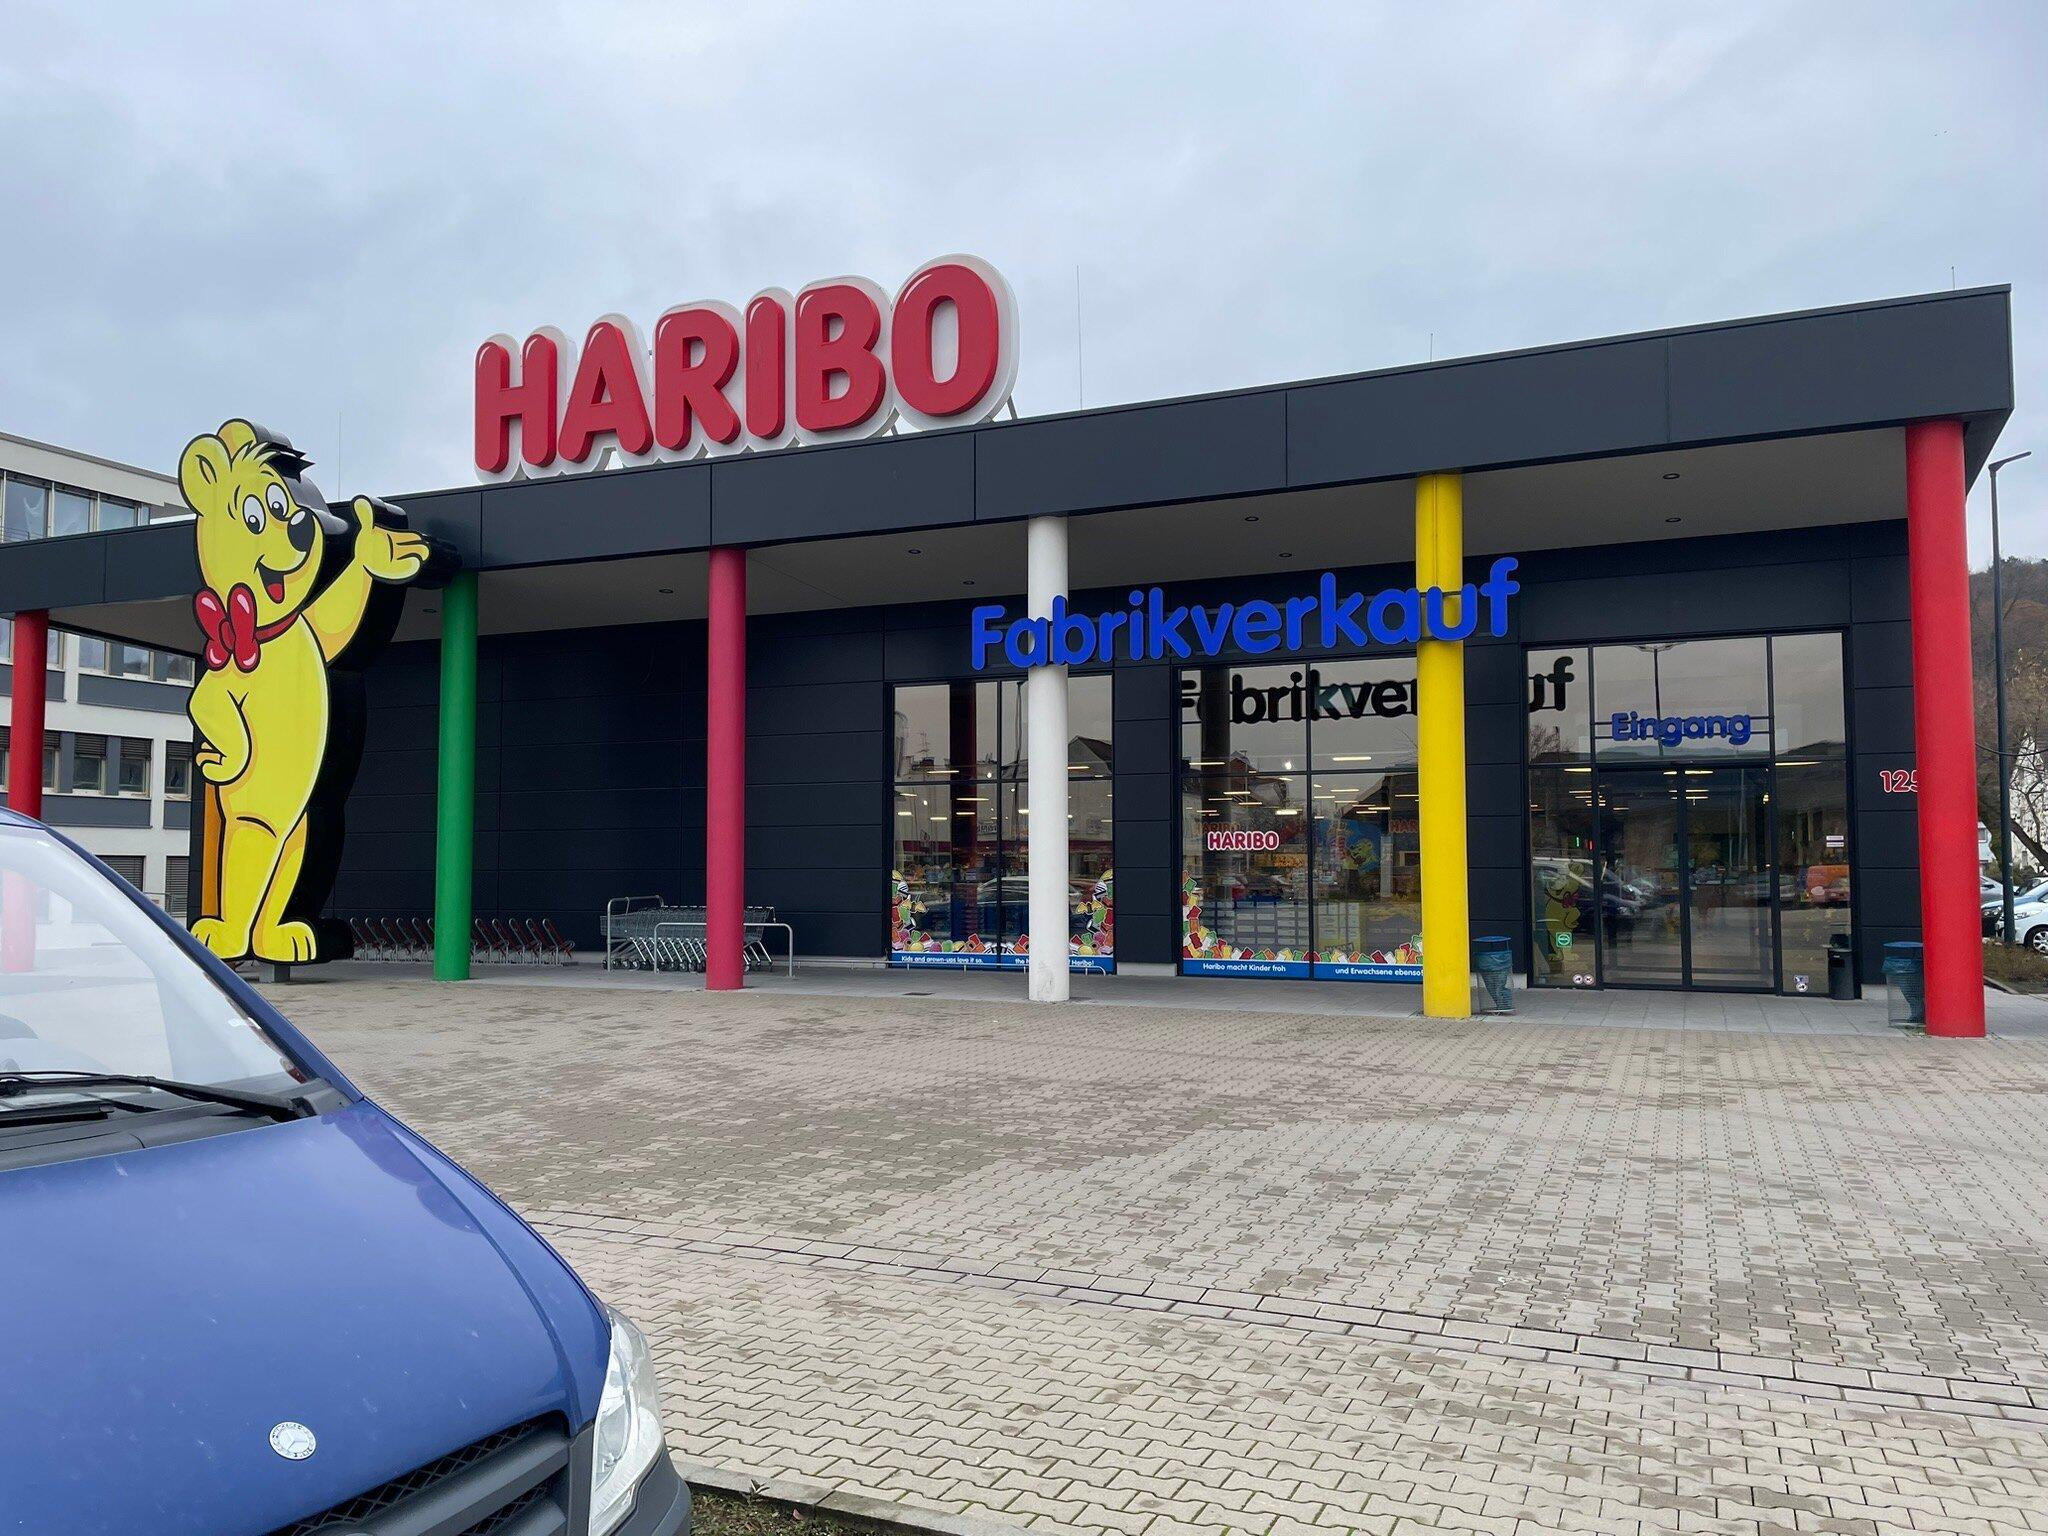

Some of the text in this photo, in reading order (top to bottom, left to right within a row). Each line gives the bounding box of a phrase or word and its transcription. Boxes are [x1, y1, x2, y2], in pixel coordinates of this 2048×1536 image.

[474, 260, 1003, 477] HARIBO
[971, 557, 1520, 671] Fabrikverkauf
[1611, 710, 1751, 748] Eingang
[1208, 831, 1279, 850] HARIBO
[1226, 963, 1248, 971] macht
[1350, 967, 1393, 975] Erwachsene
